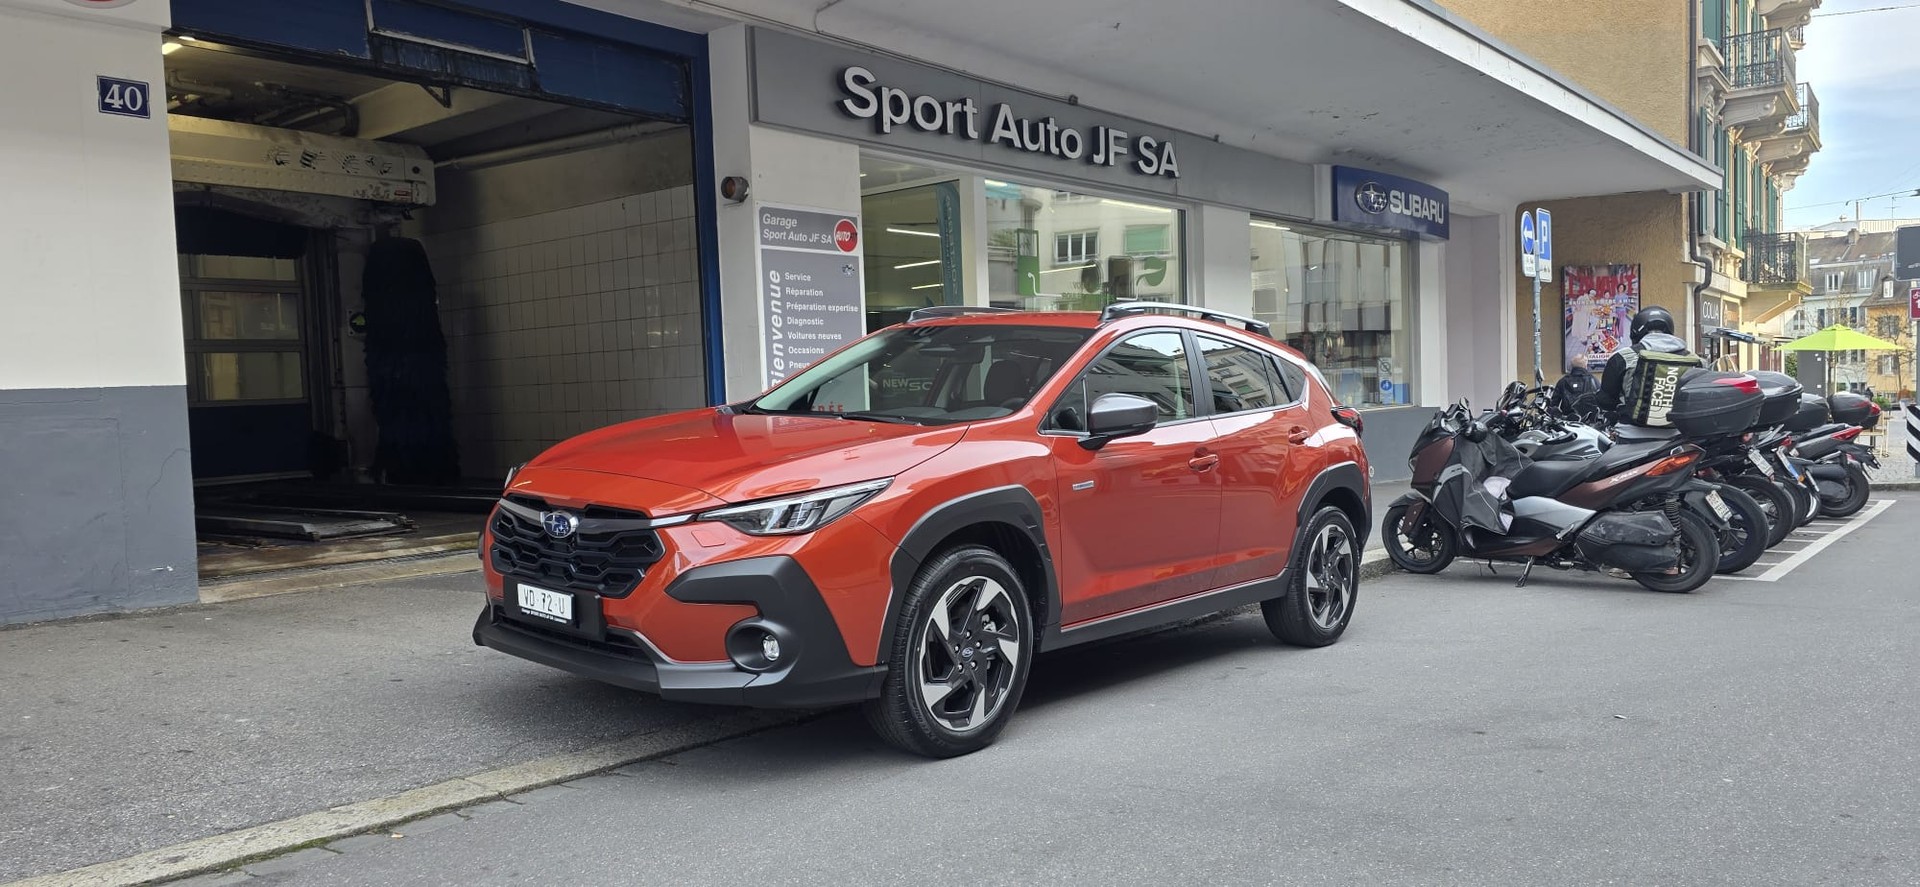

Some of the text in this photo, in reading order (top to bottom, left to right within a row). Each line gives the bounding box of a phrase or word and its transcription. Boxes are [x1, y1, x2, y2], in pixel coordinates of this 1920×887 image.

[104, 84, 143, 111] 40
[841, 66, 1180, 178] Sport Auto JF SA
[1389, 189, 1444, 225] SUBARU
[762, 213, 798, 229] Garage
[763, 229, 832, 244] Sport Auto JF SA
[1540, 220, 1548, 254] P
[784, 272, 812, 281] Service
[785, 287, 824, 297] Réparation
[786, 302, 859, 312] Préparation expertise
[787, 317, 824, 326] Diagnostic
[787, 331, 842, 340] Voitures neuves
[788, 346, 824, 354] Occasions
[883, 380, 908, 388] NEW
[1662, 366, 1679, 407] NORTH
[1650, 377, 1666, 407] FACE
